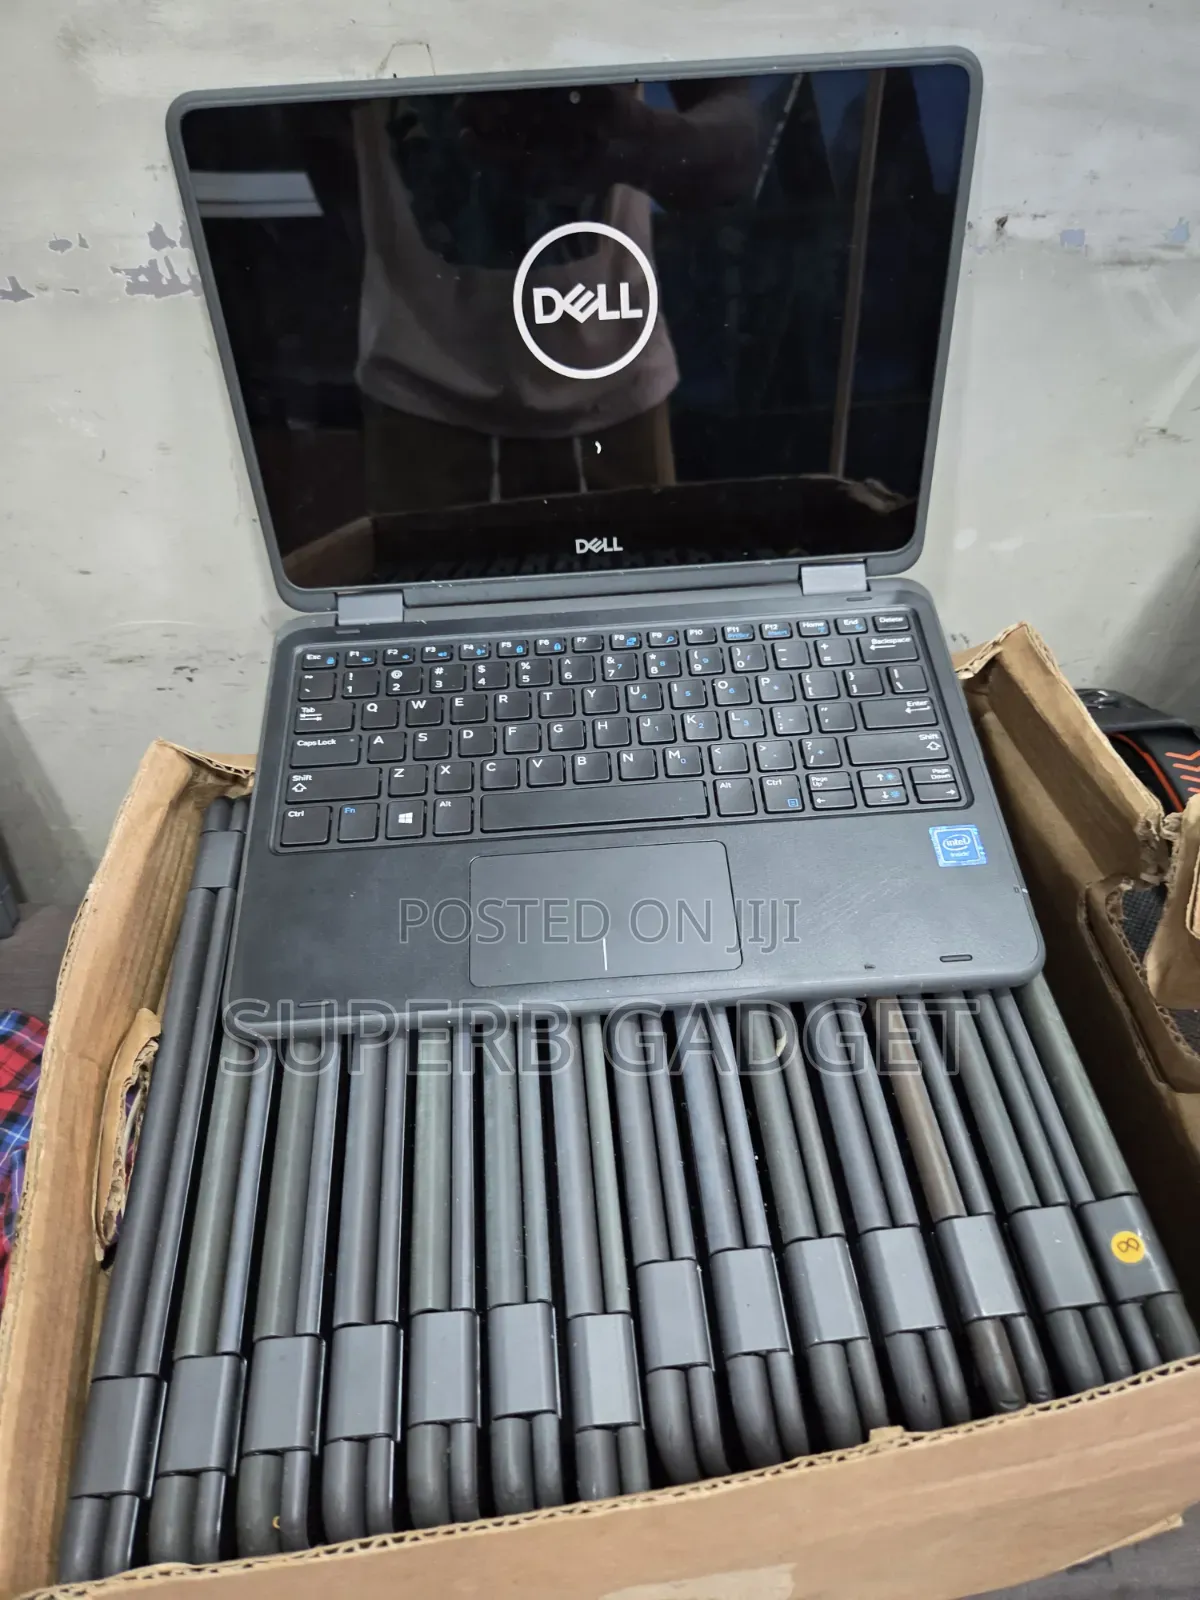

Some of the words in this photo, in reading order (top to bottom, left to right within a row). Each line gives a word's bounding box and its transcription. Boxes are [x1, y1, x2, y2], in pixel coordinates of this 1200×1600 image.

[533, 282, 643, 324] DELL
[575, 536, 623, 554] DELL
[478, 665, 485, 673] $
[521, 662, 531, 670] %
[391, 670, 402, 678] @
[718, 681, 728, 689] O
[761, 678, 770, 686] P
[630, 687, 639, 695] U
[673, 684, 677, 692] I
[543, 692, 552, 700] T
[587, 690, 596, 698] Y
[455, 698, 463, 706] E
[499, 695, 508, 703] R
[367, 703, 378, 712] Q
[412, 700, 426, 708] W
[687, 715, 696, 723] K
[732, 712, 740, 720] L
[598, 722, 608, 730] H
[418, 733, 428, 741] S
[463, 730, 473, 738] D
[373, 736, 384, 744] A
[578, 757, 587, 765] B
[623, 753, 633, 762] N
[486, 763, 496, 771] C
[532, 759, 543, 768] V
[394, 769, 404, 777] Z
[441, 766, 450, 774] X
